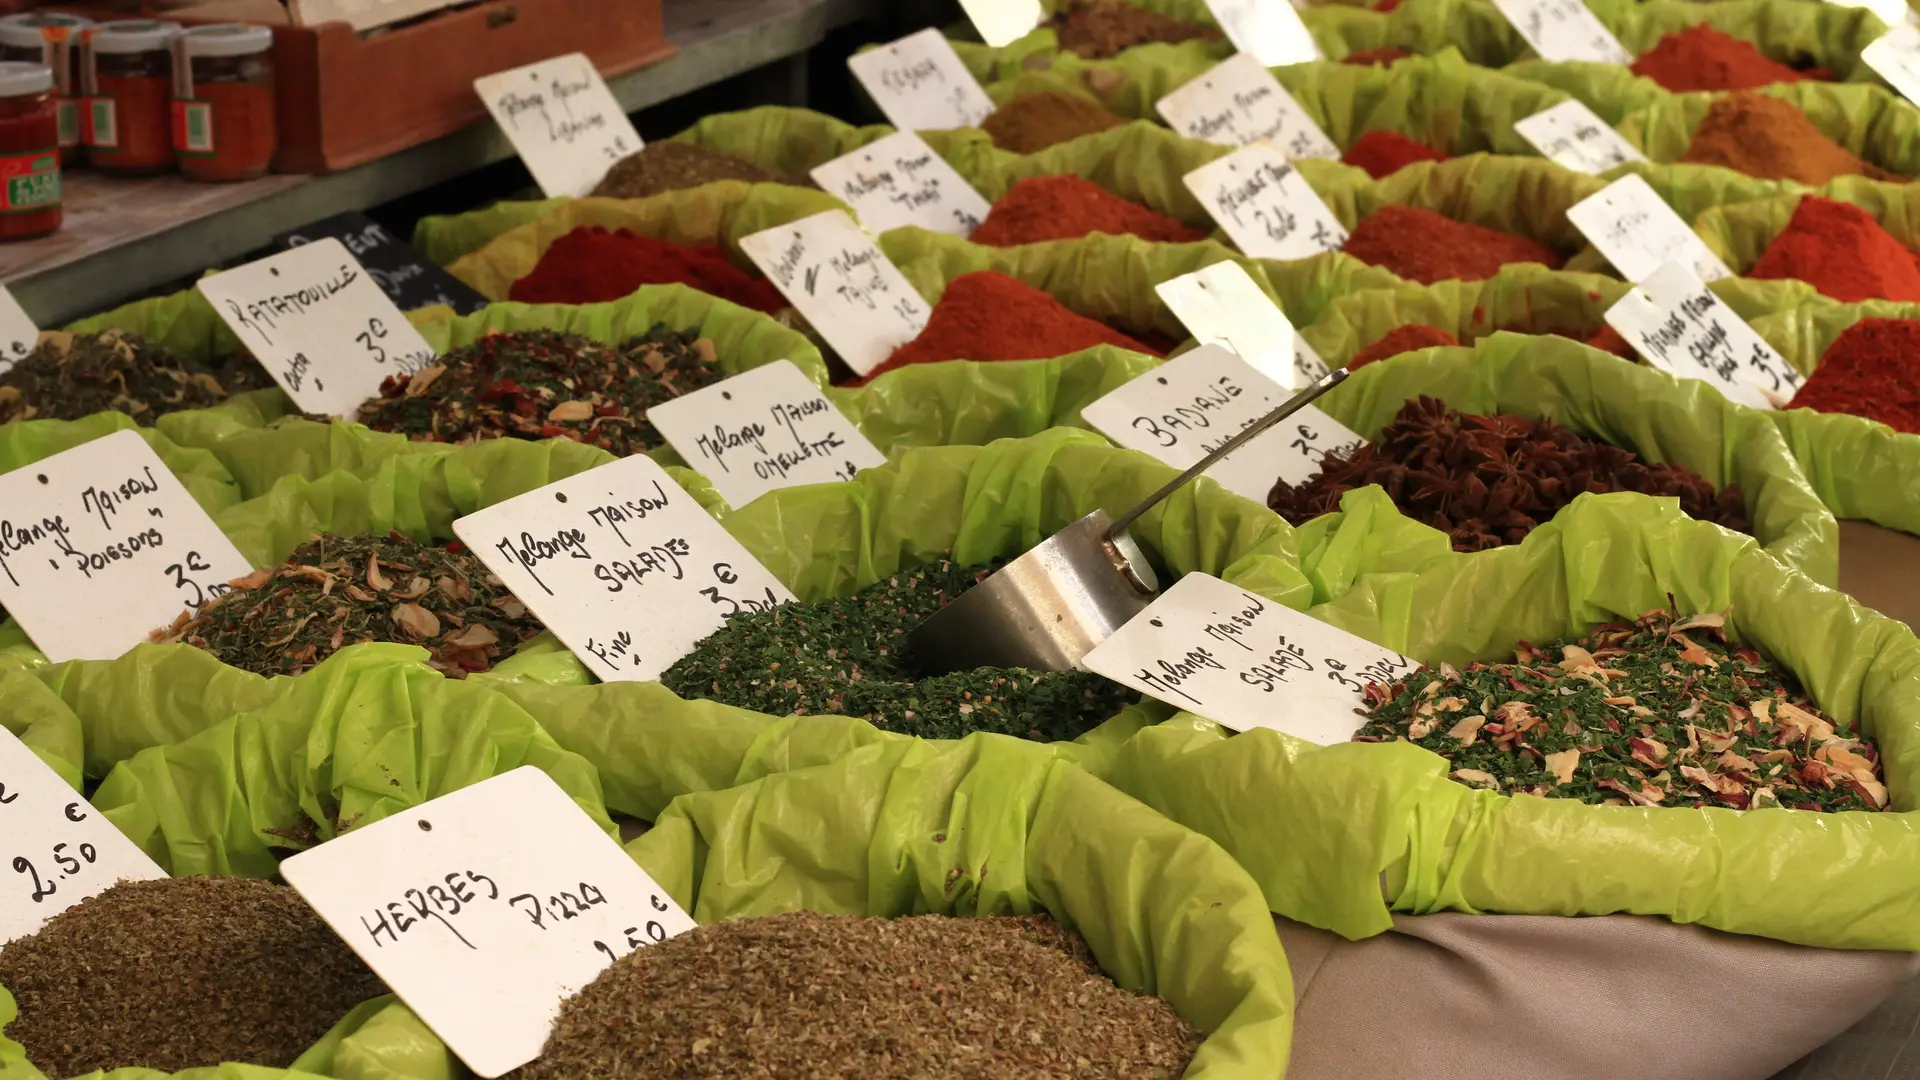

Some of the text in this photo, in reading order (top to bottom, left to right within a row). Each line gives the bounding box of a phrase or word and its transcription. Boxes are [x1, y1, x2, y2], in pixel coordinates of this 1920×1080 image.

[226, 264, 358, 346] RATATOUILLE
[695, 423, 769, 473] Melange
[496, 528, 592, 596] Melange
[594, 538, 691, 593] SALADES
[1133, 646, 1227, 706] Melange
[360, 870, 499, 950] HERBES
